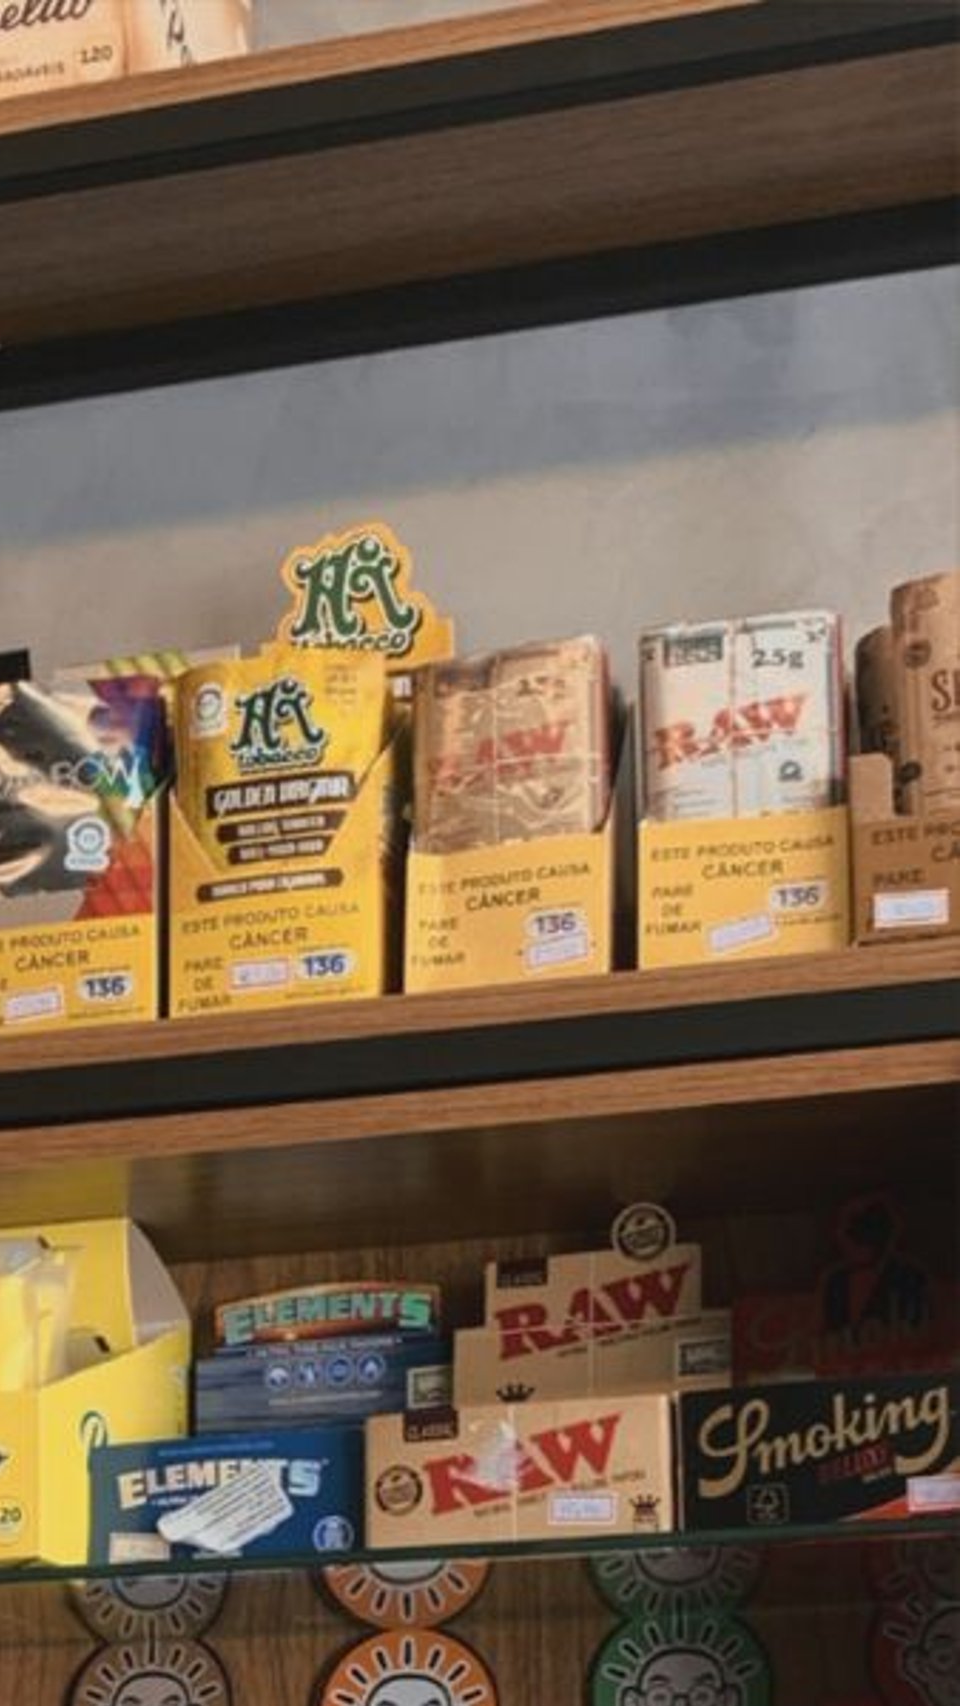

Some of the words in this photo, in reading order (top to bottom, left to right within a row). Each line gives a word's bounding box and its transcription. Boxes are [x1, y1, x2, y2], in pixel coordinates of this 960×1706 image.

[653, 694, 810, 772] RAW
[534, 913, 576, 935] 136
[777, 886, 820, 907] 136
[82, 974, 126, 997] 136
[303, 953, 347, 976] 136
[220, 1290, 436, 1346] ELEMENTS
[494, 1263, 691, 1361] RAW
[697, 1386, 950, 1499] Smoking
[117, 1457, 320, 1512] ELEMETS
